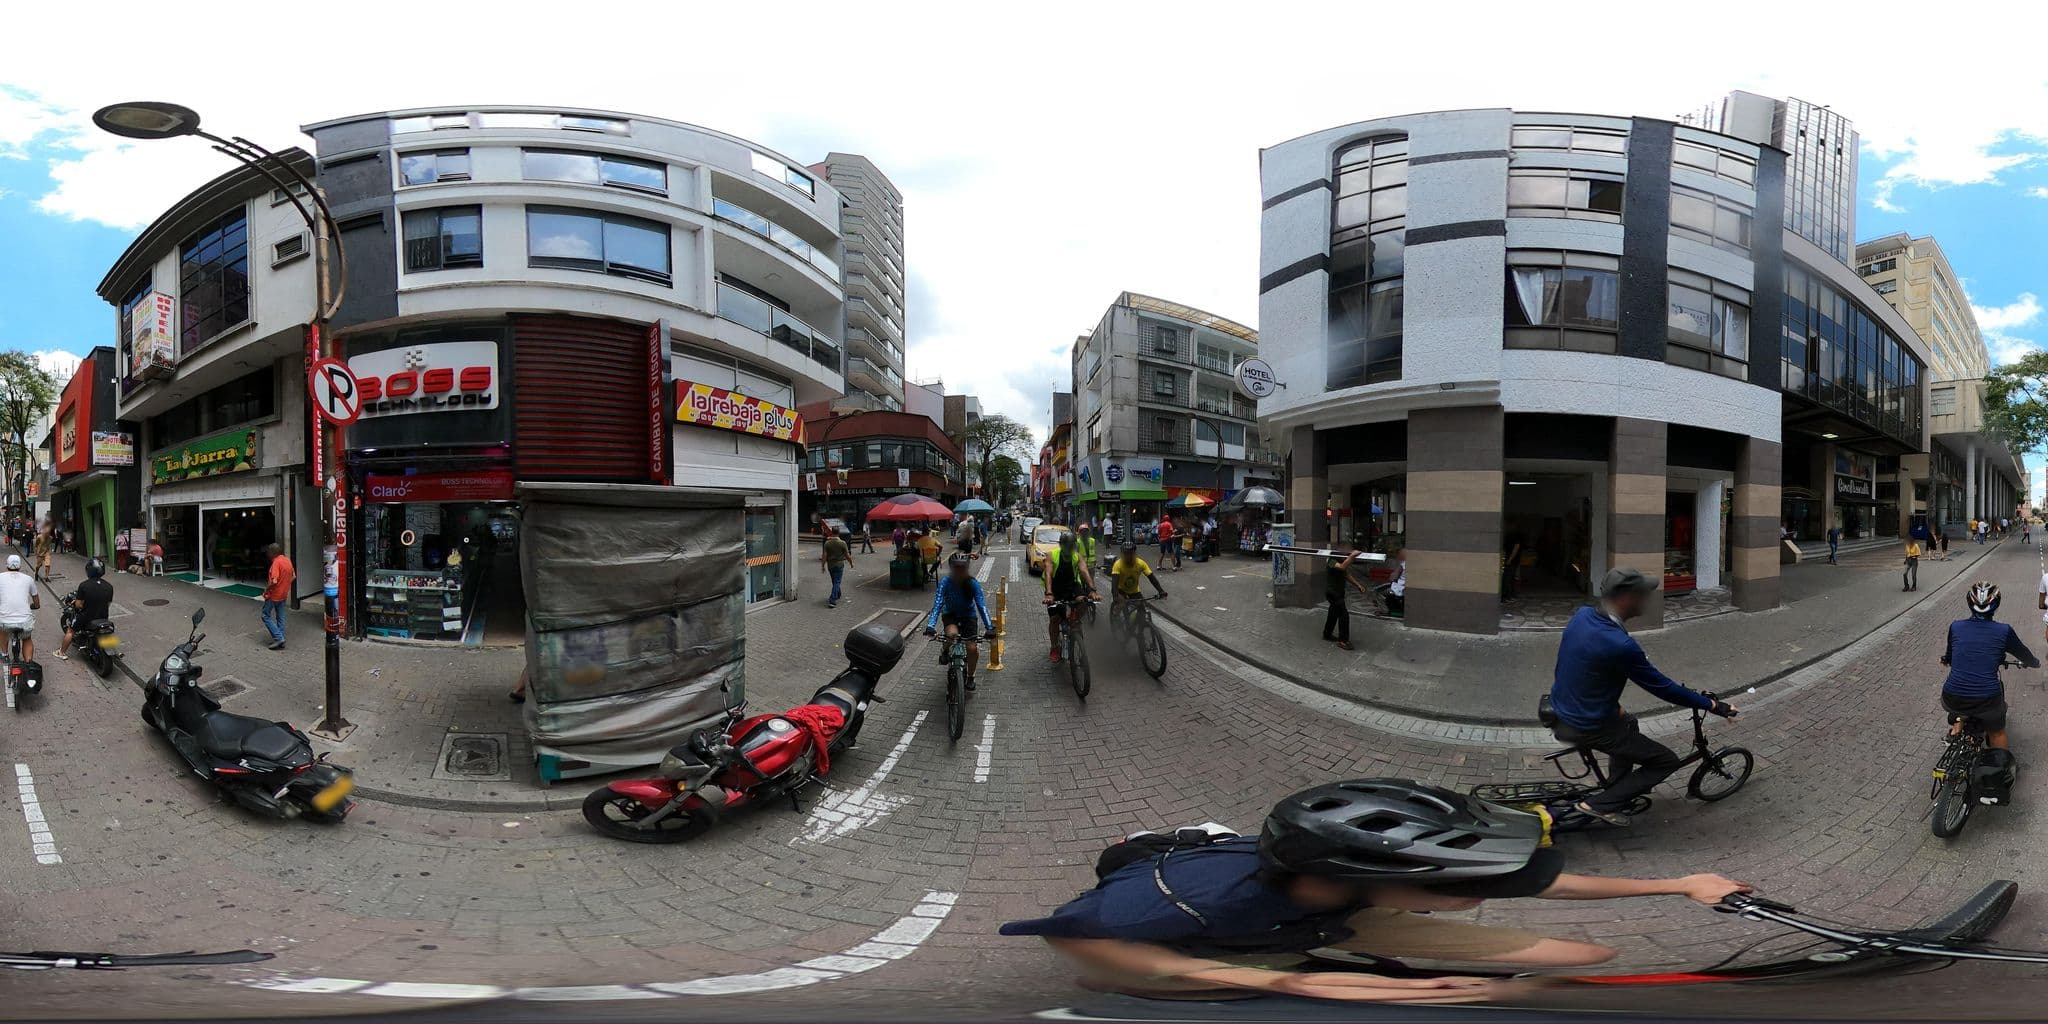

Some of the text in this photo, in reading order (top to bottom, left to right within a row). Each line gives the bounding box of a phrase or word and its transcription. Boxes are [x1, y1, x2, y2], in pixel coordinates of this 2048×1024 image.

[157, 296, 171, 335] HOTEL
[357, 366, 491, 401] BOSS
[1244, 367, 1272, 380] HOTEL
[361, 393, 492, 414] ECHNOLOGY
[650, 327, 661, 473] CAMBIO DE VISORES
[711, 397, 763, 427] rebaja
[764, 407, 794, 431] plus
[166, 460, 180, 472] La
[190, 447, 237, 466] Jarra
[371, 485, 407, 498] Claro
[848, 487, 877, 495] CELULAR
[336, 498, 347, 548] Claro
